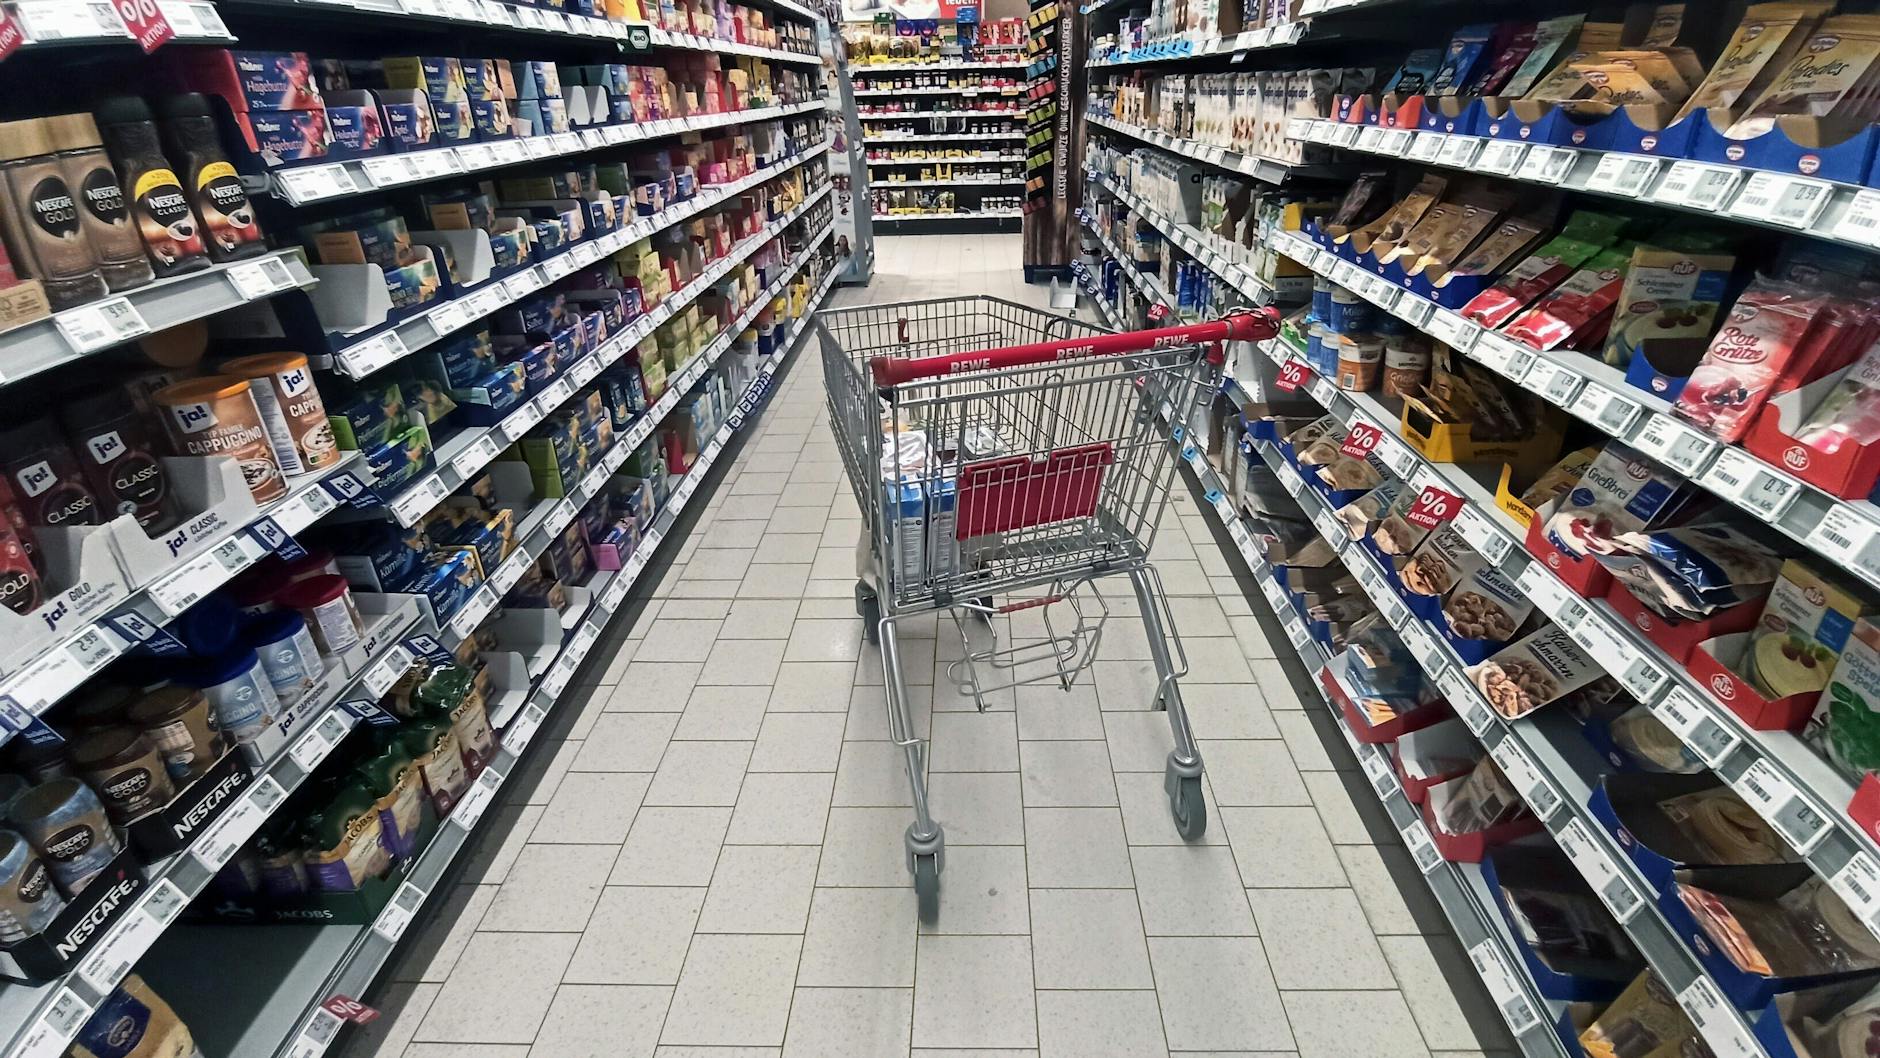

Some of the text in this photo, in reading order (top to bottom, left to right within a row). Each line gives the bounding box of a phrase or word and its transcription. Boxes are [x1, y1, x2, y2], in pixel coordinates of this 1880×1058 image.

[140, 21, 167, 49] AKTION
[95, 198, 125, 212] GOLD
[157, 204, 188, 216] CLASSIC
[44, 209, 75, 224] GOLD
[1673, 264, 1696, 273] RUF
[1154, 334, 1189, 347] REWE
[1724, 327, 1761, 347] Rote
[1056, 345, 1094, 359] REWE
[1713, 342, 1763, 360] Grütze
[950, 357, 990, 372] REWE
[1282, 364, 1301, 383] %
[282, 369, 305, 393] ja!
[177, 404, 209, 429] ja!
[93, 434, 119, 459] ja!
[187, 426, 263, 455] CAPPUCCINO
[1352, 426, 1374, 449] %
[1342, 445, 1367, 457] AKTION
[1785, 451, 1807, 466] RUF
[23, 466, 49, 492] ja!
[115, 464, 159, 490] CLASSIC
[1627, 462, 1649, 480] RUF
[1588, 468, 1632, 500] Grießbrei
[1763, 479, 1789, 496] 0.75
[47, 495, 92, 524] CLASSIC
[1420, 491, 1447, 516] %
[1408, 513, 1439, 527] AKTION
[165, 512, 219, 558] ja! CLASSIC
[1805, 587, 1825, 605] RUF
[42, 600, 69, 632] ja!
[68, 582, 92, 602] GOLD
[76, 629, 99, 651] 2.99
[362, 637, 378, 657] ja!
[1529, 637, 1578, 680] schmarrn
[1713, 677, 1733, 696] RUF
[277, 712, 296, 736] ja!
[112, 780, 147, 799] GOLD
[1796, 807, 1822, 830] 0.79
[343, 814, 374, 847] JACOBS
[56, 838, 90, 859] GOLD
